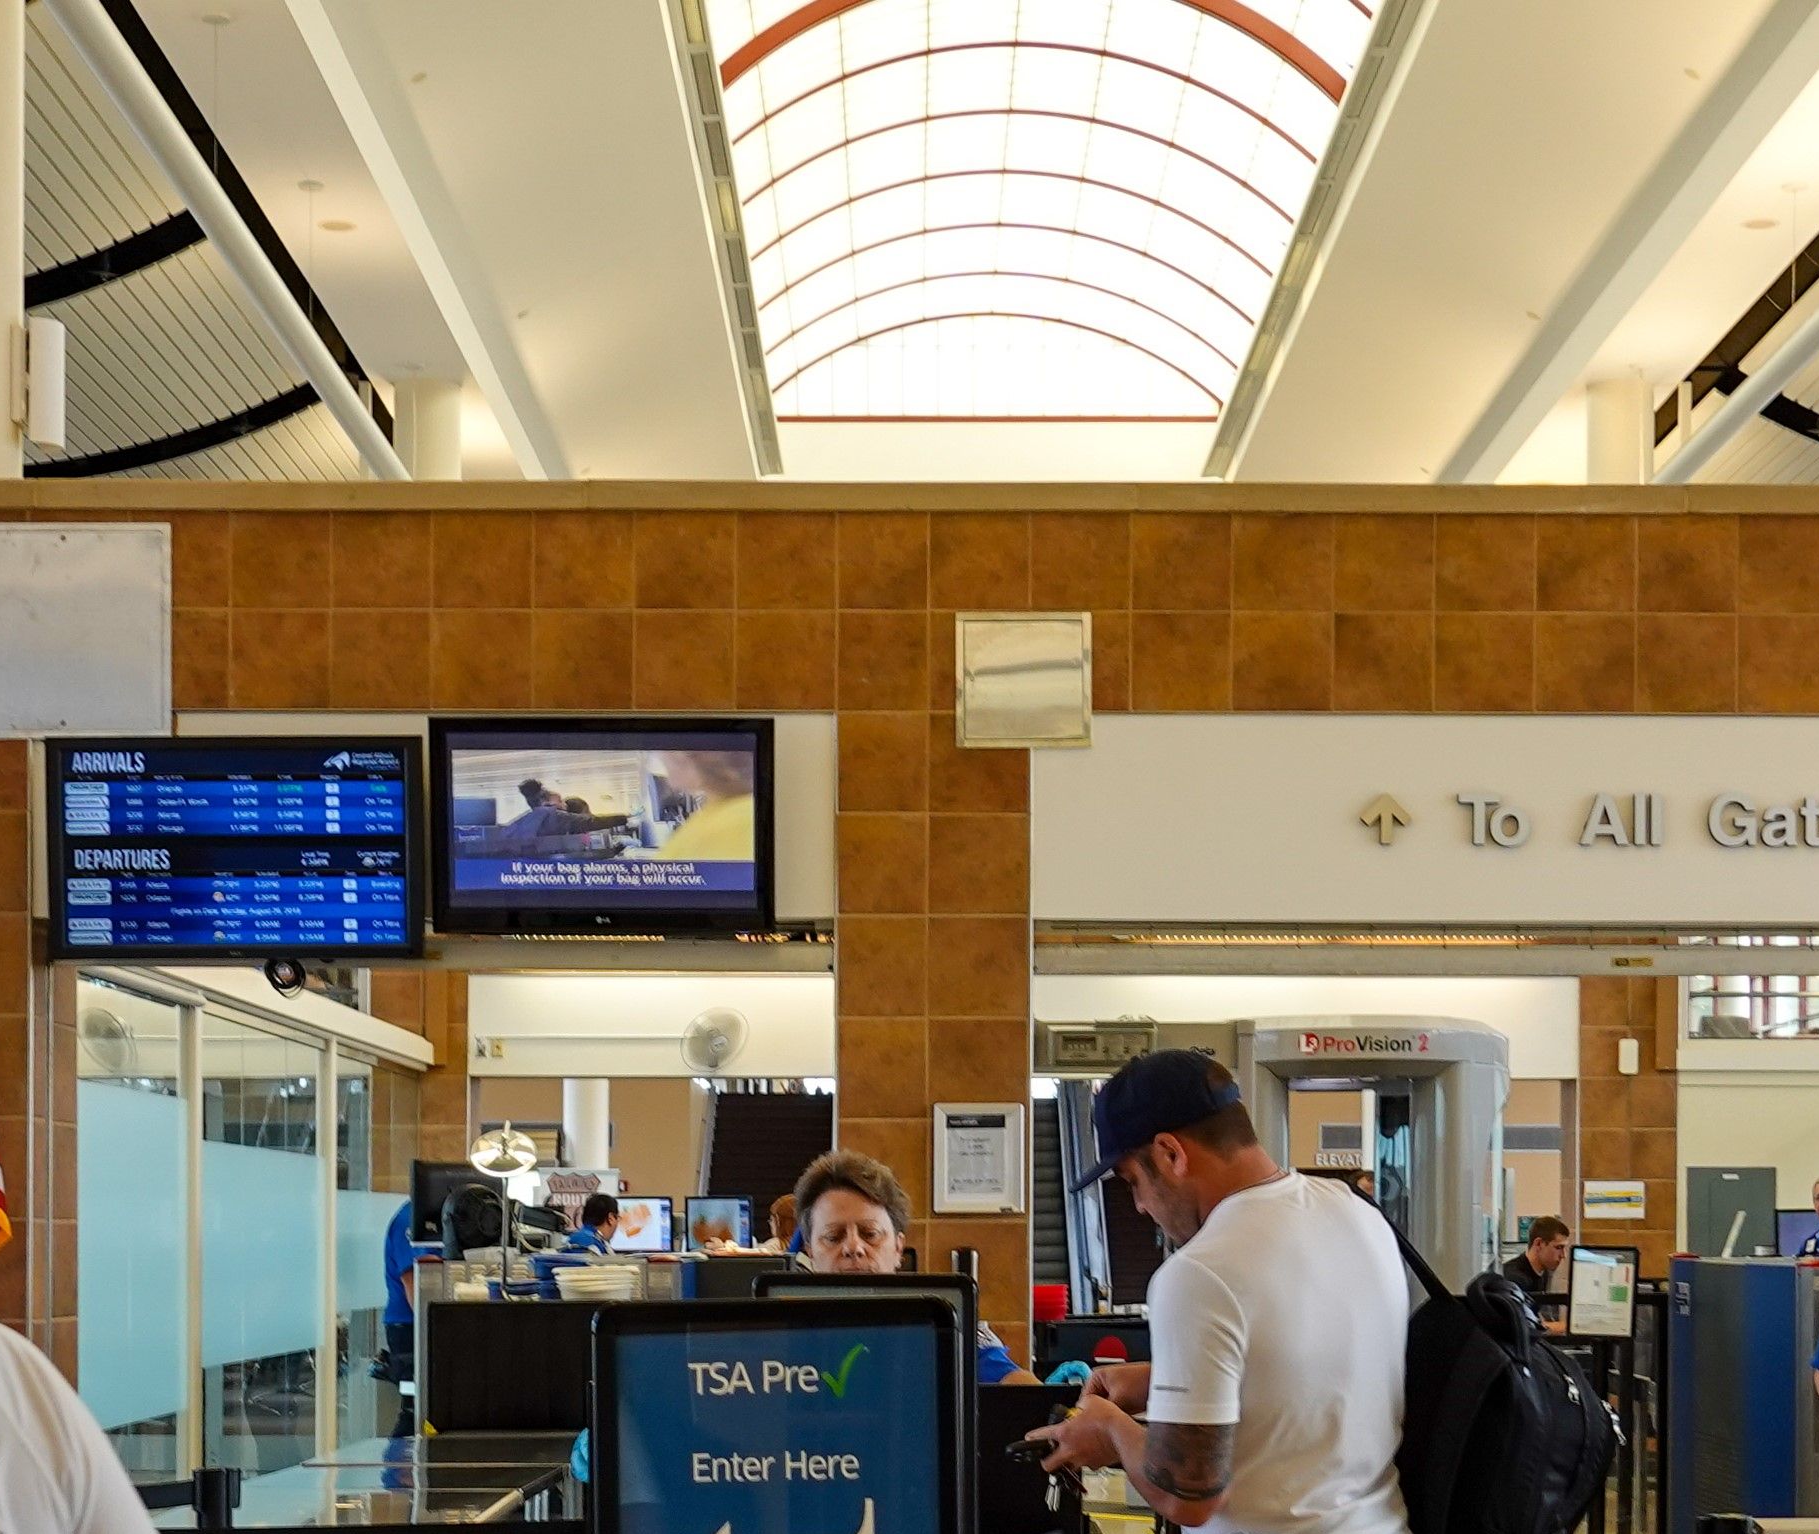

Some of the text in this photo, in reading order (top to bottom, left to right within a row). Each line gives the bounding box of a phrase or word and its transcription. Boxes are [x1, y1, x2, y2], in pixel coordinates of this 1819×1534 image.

[72, 752, 146, 773] ARRIVALS
[1457, 793, 1531, 848] To
[1579, 793, 1662, 847] All
[74, 848, 171, 871] DEPARTURES
[512, 862, 695, 875] If your bag alarms, a physical
[568, 873, 582, 884] of
[584, 875, 613, 886] your
[617, 873, 640, 886] bag
[643, 873, 666, 884] will
[668, 874, 707, 885] occur.
[1322, 1035, 1413, 1052] ProVision
[1418, 1032, 1430, 1053] 2
[1315, 1153, 1363, 1167] ELEVAT
[688, 1360, 819, 1396] TSA Pre
[692, 1450, 860, 1483] Enter Here
